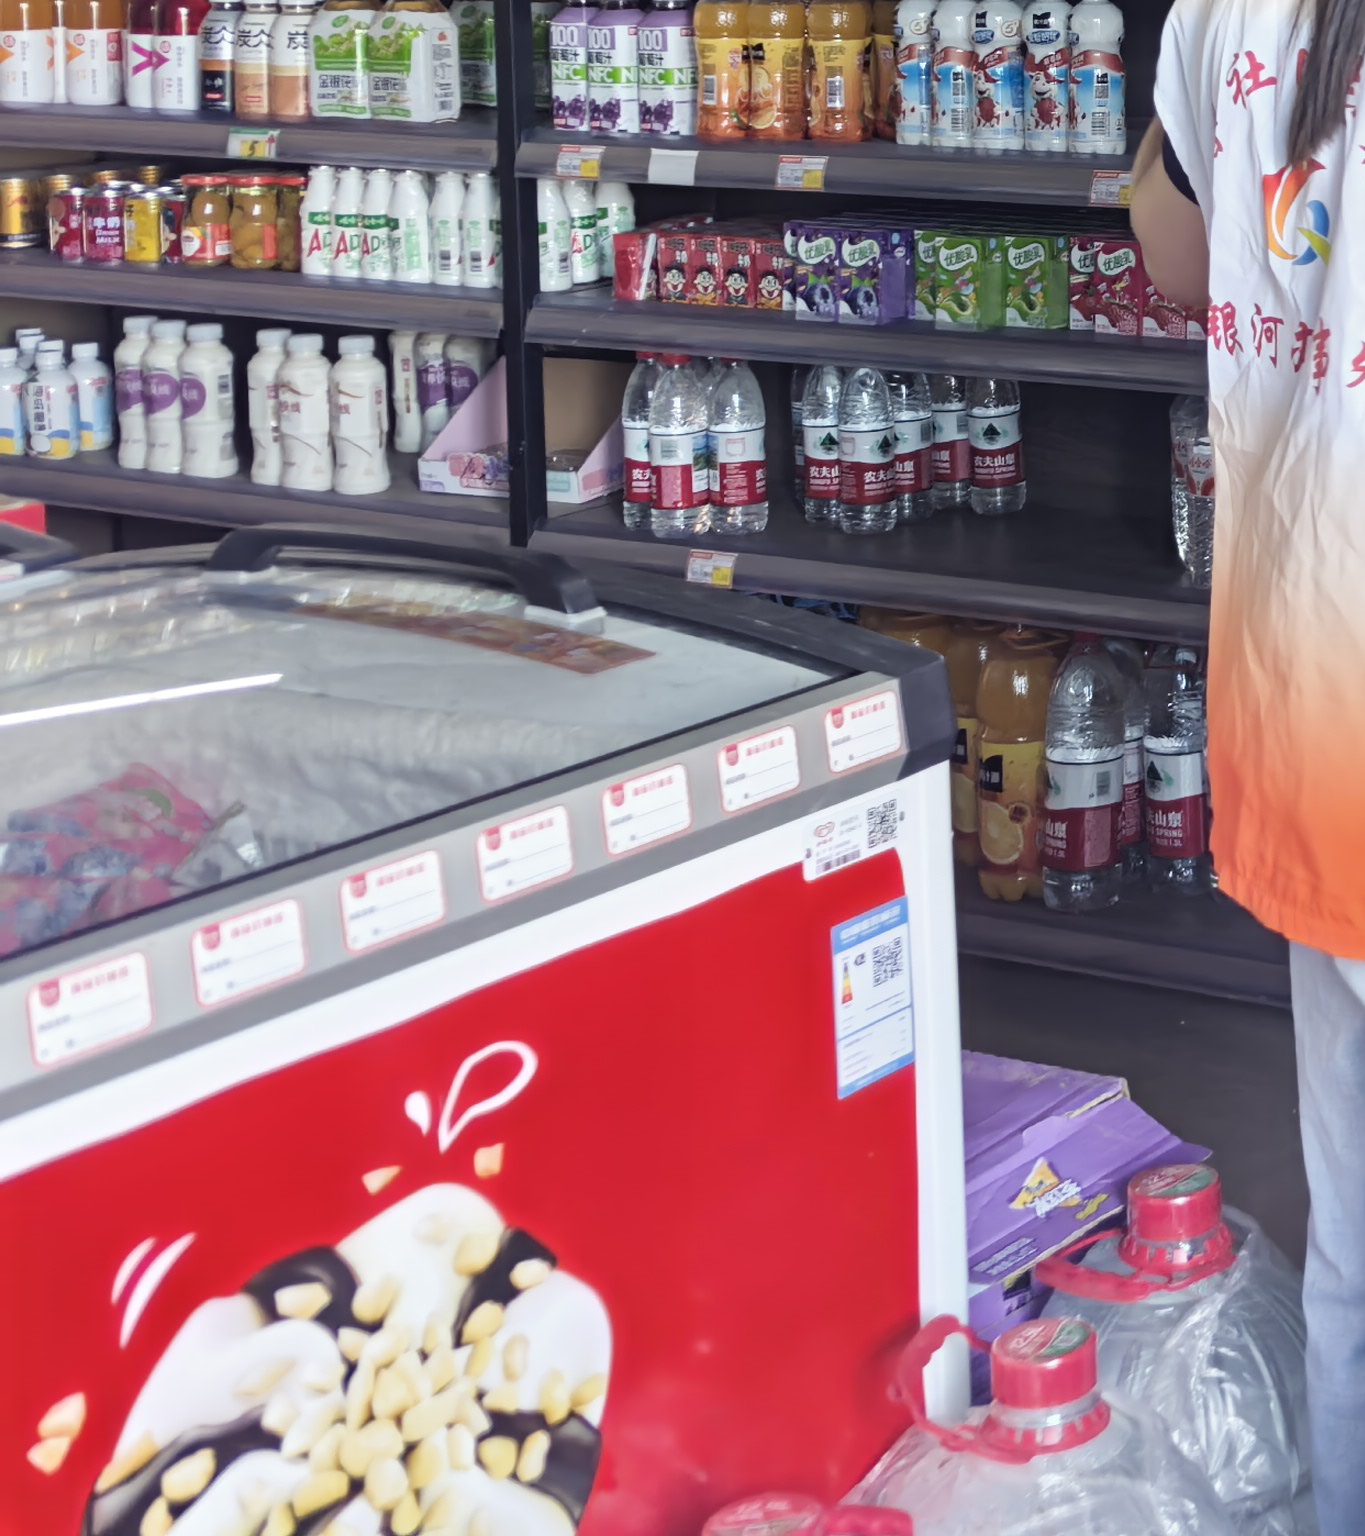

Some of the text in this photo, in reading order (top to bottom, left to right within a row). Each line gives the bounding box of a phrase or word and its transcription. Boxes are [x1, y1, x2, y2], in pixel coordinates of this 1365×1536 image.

[638, 29, 662, 51] 100
[552, 64, 583, 81] NFC
[588, 67, 614, 84] NFC
[639, 68, 665, 85] NFC
[804, 243, 833, 259] 优酸乳
[850, 244, 877, 260] 优酸乳
[944, 249, 973, 265] 优酸乳
[1012, 250, 1042, 265] 优酸乳
[1102, 254, 1133, 270] 优酸乳
[974, 453, 1016, 468] 农夫山泉
